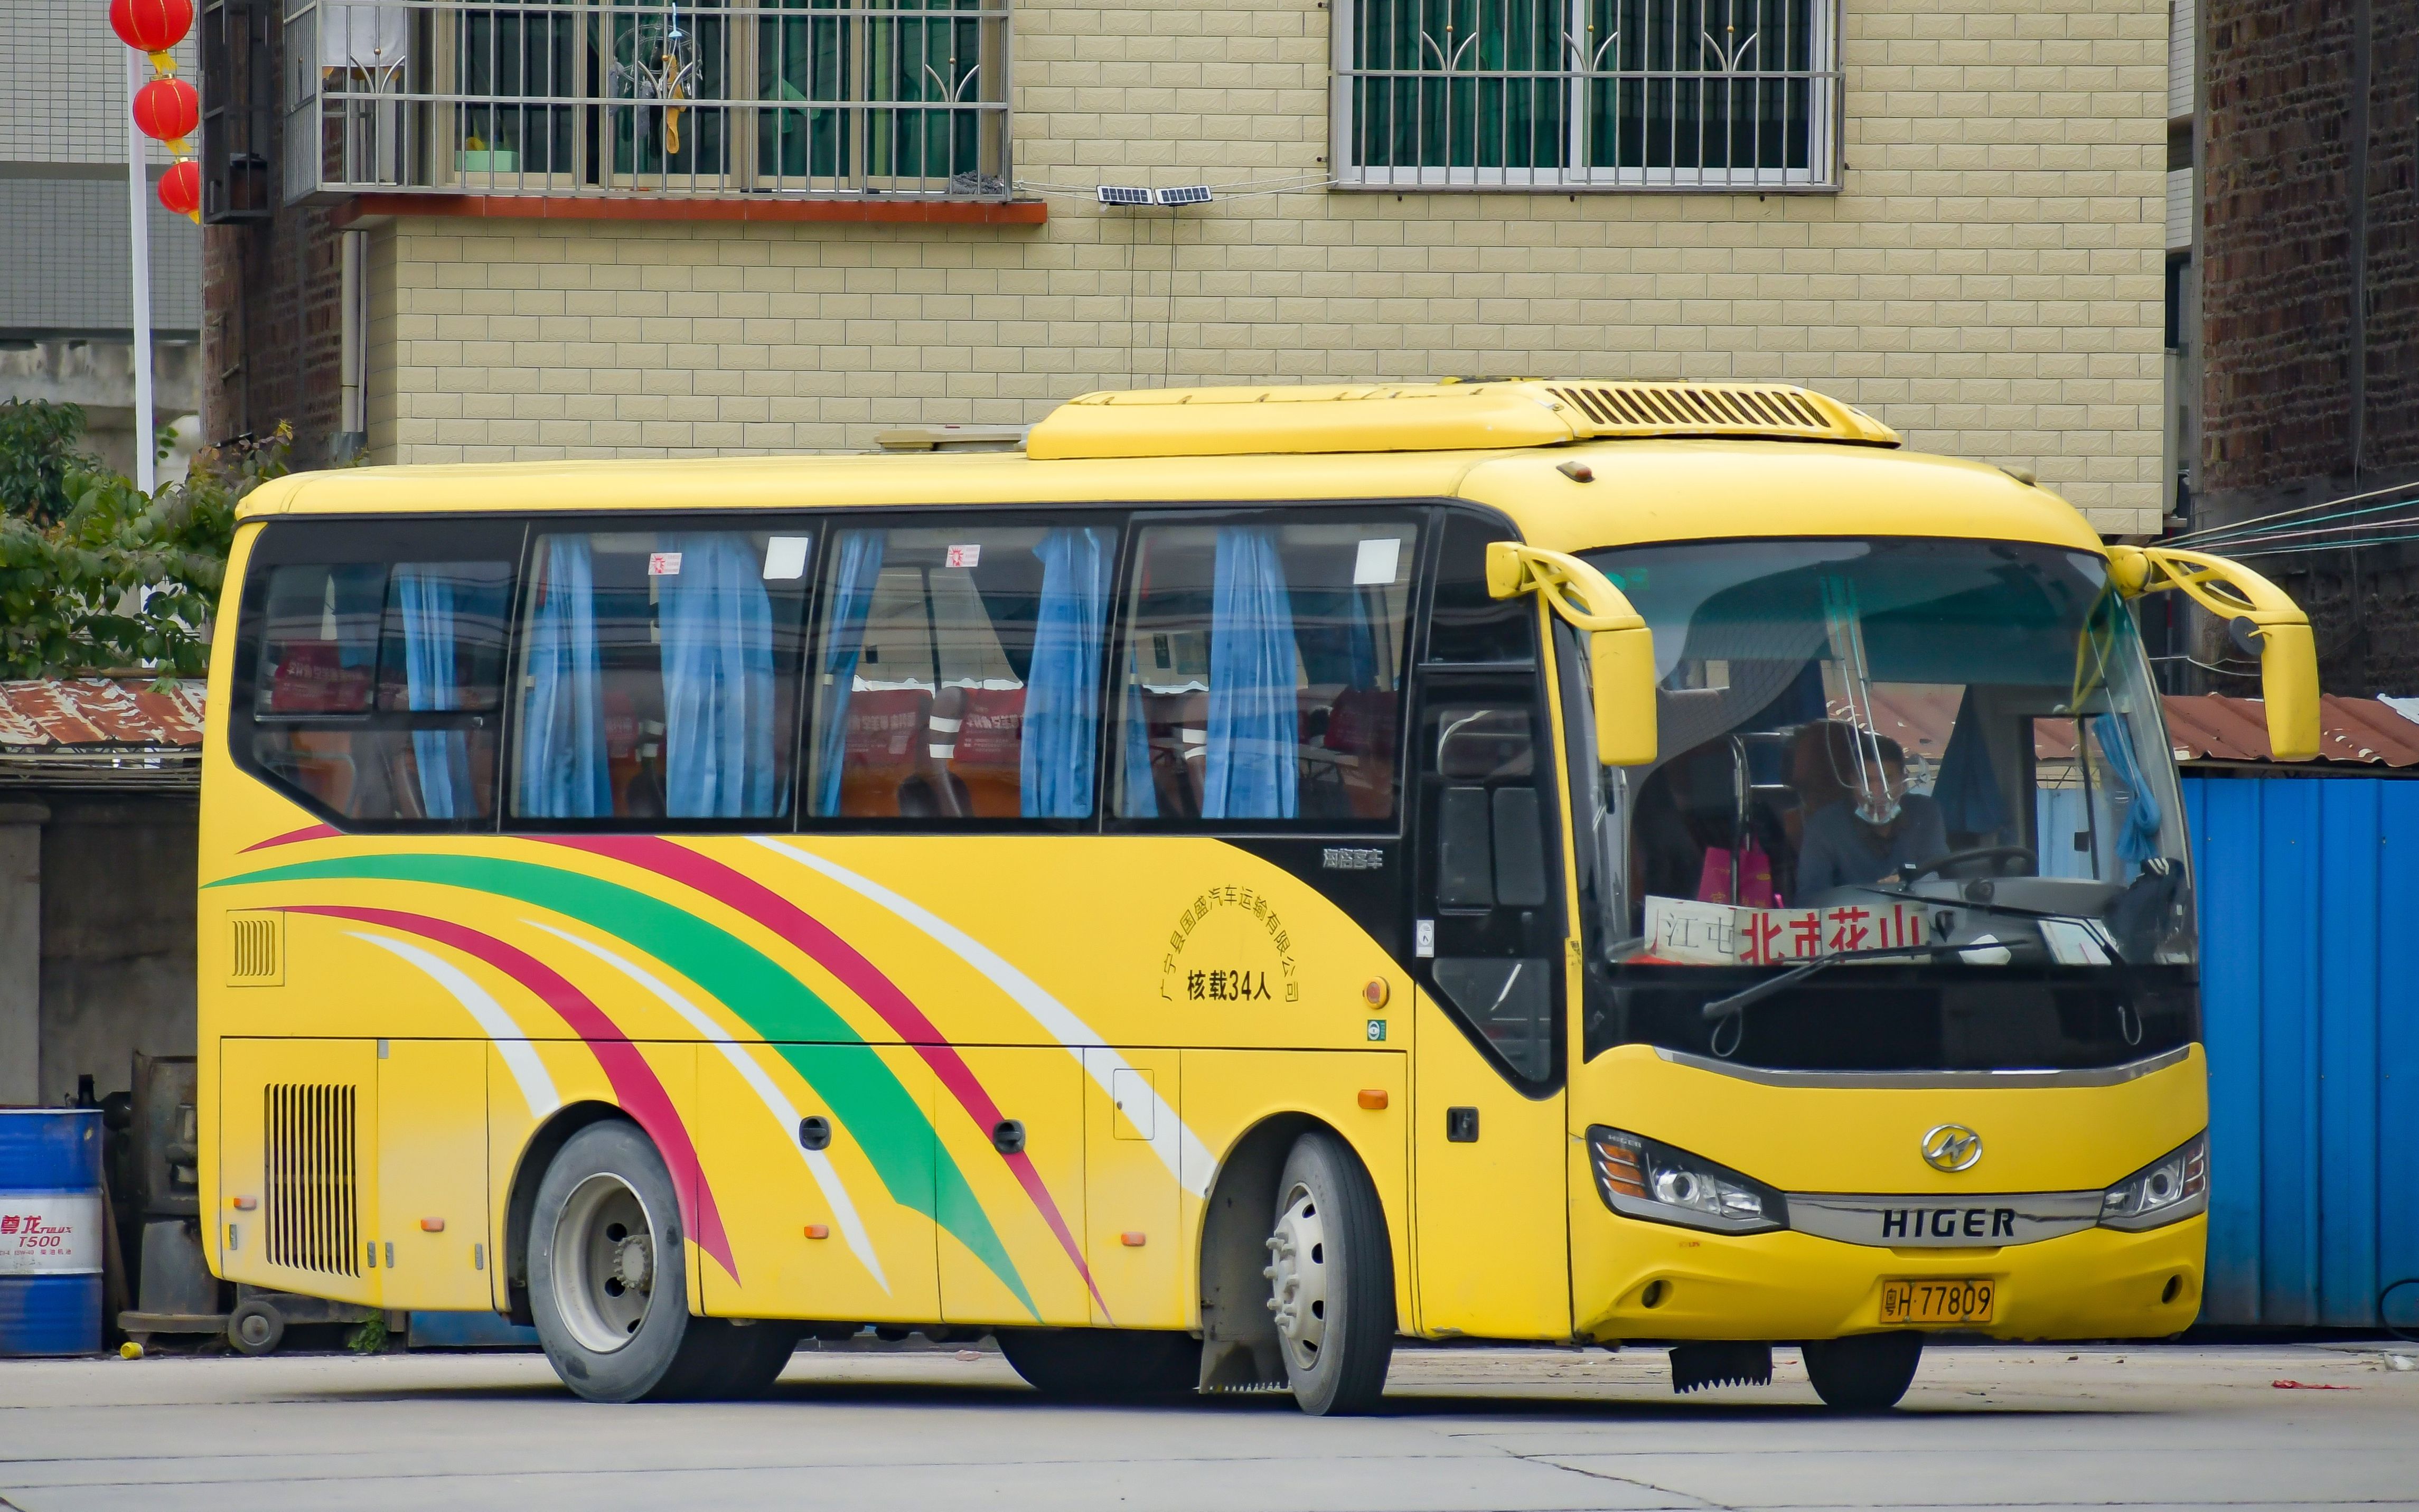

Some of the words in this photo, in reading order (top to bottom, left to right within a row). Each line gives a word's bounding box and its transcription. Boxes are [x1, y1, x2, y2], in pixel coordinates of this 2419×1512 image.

[1187, 970, 1272, 1001] 核载34人
[1, 1215, 42, 1234] 尊龙
[1882, 1208, 2016, 1238] HIGER
[19, 1236, 61, 1247] T500
